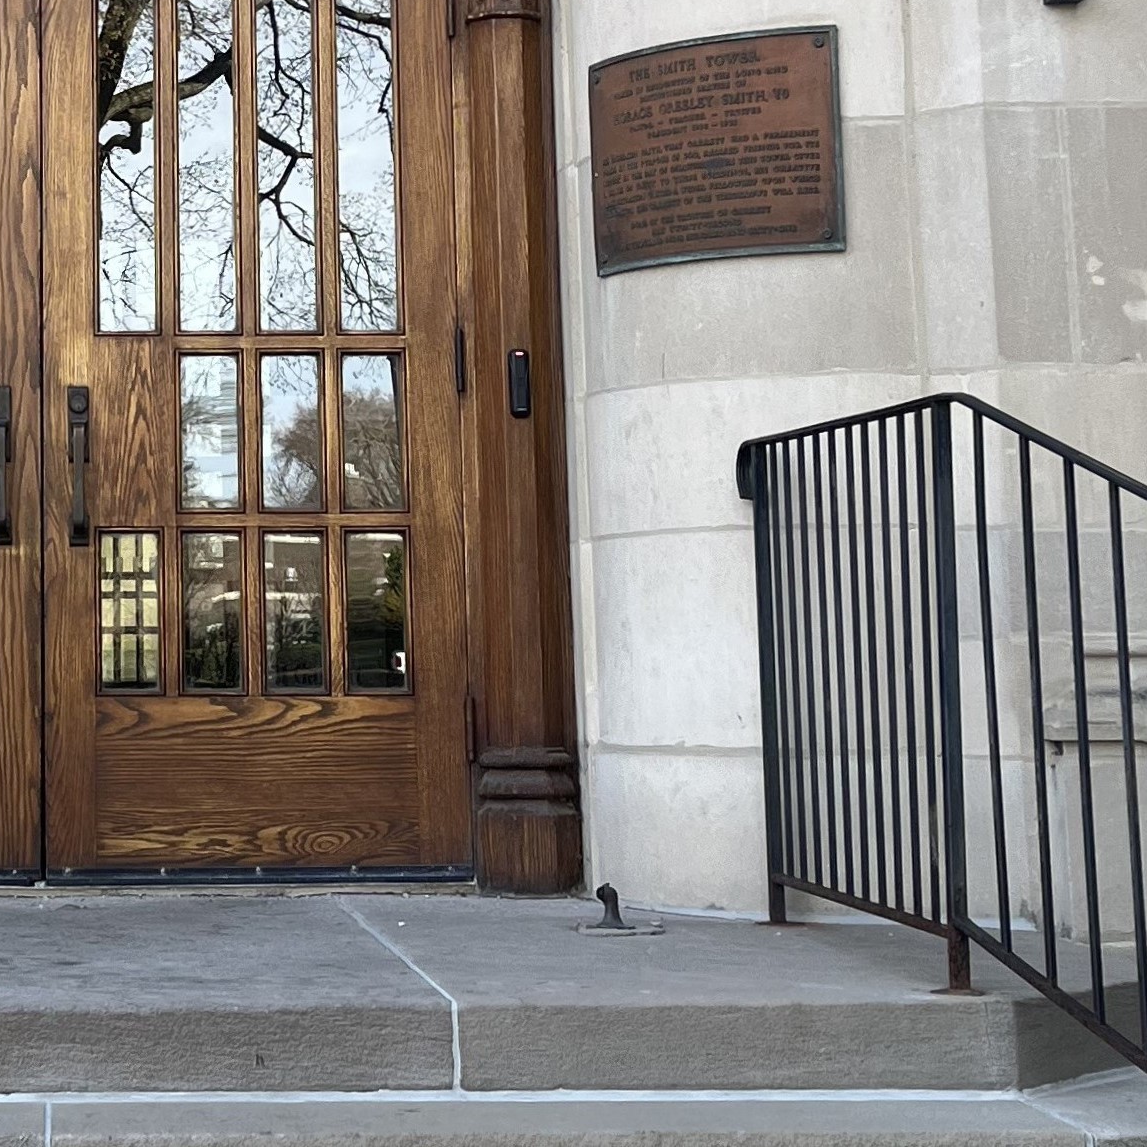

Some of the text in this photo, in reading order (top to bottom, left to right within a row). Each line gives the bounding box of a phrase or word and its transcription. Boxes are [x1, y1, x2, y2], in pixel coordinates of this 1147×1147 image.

[629, 67, 650, 83] THE
[657, 58, 696, 77] SMITH
[705, 50, 759, 67] TOWER
